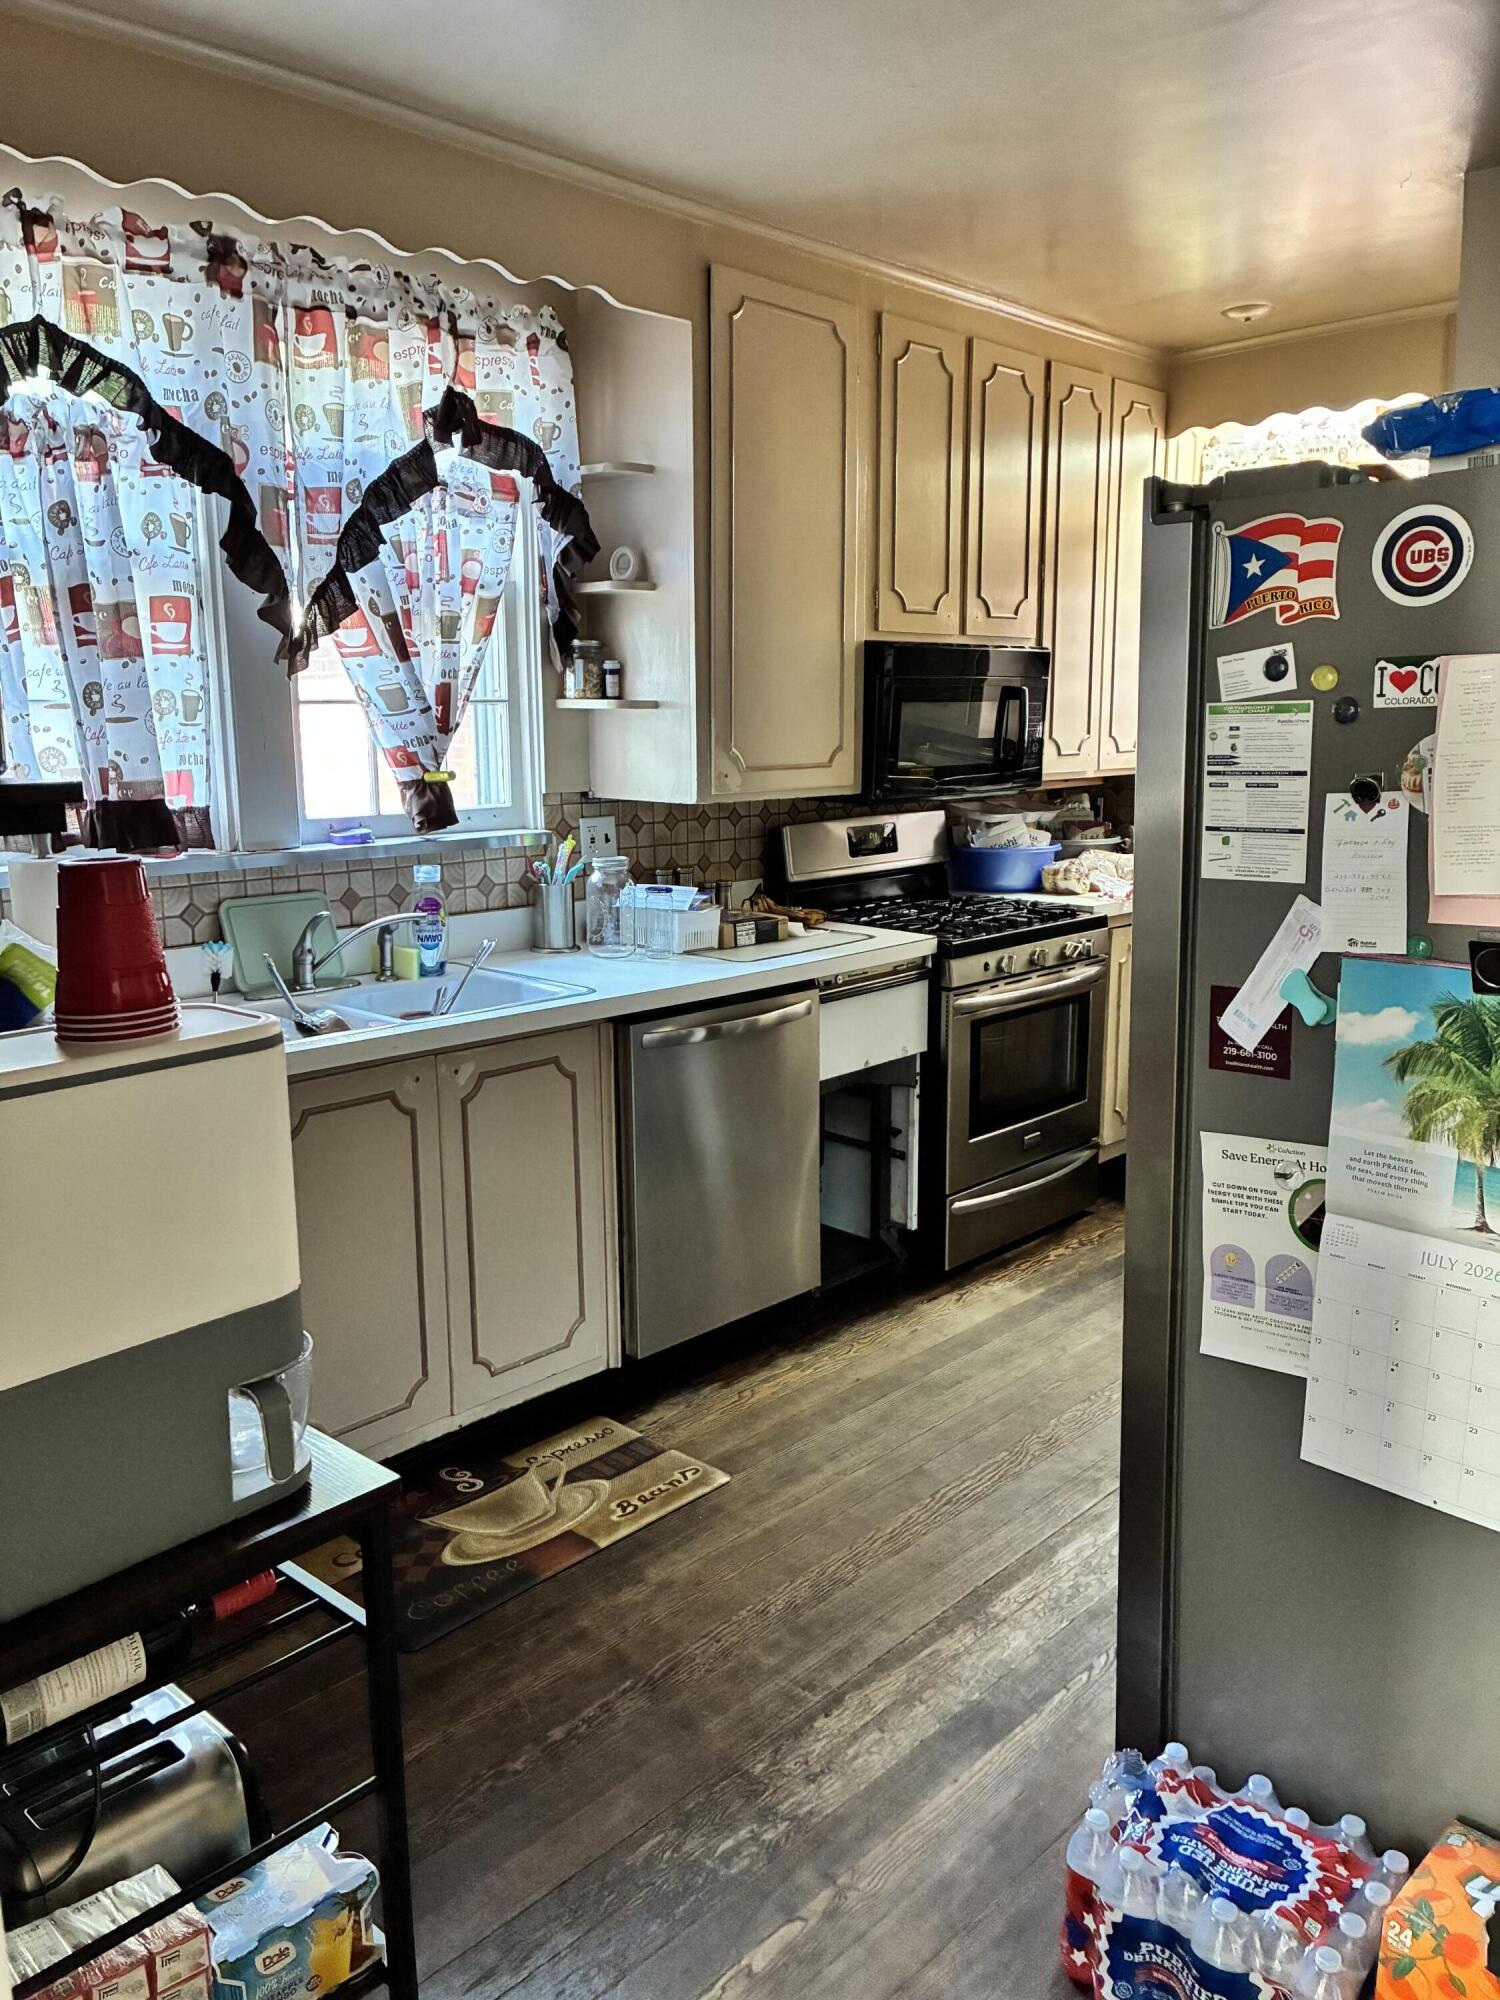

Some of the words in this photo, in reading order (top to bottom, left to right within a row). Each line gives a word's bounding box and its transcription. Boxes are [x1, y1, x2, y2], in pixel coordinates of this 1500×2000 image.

[1245, 589, 1297, 611] PUERTO
[1299, 598, 1333, 614] RICO
[1384, 696, 1436, 706] COLORADO
[417, 933, 443, 943] DAWN
[1223, 1046, 1278, 1061] 219-661-3100
[1221, 1149, 1248, 1162] Save
[1349, 1156, 1362, 1164] and
[1362, 1158, 1381, 1168] earth
[1382, 1162, 1409, 1173] PRAISE
[1363, 1148, 1375, 1157] Let
[1376, 1151, 1387, 1160] the
[1388, 1154, 1414, 1165] heaven
[1345, 1163, 1357, 1172] the
[1357, 1167, 1375, 1177] seas,
[1375, 1170, 1388, 1179] and
[1389, 1174, 1409, 1184] every
[1351, 1174, 1366, 1184] that
[1366, 1178, 1392, 1189] moveth
[1208, 1188, 1231, 1198] ENERGY
[1232, 1191, 1246, 1199] USE
[1246, 1194, 1263, 1202] WITH
[1264, 1197, 1284, 1206] THESE
[1212, 1181, 1225, 1189] CUT
[1226, 1183, 1248, 1192] DOWN
[1248, 1186, 1259, 1194] ON
[1260, 1188, 1278, 1197] YOUR
[1211, 1197, 1234, 1206] SIMPLE
[1235, 1200, 1249, 1208] TIPS
[1249, 1203, 1264, 1211] YOU
[1264, 1205, 1279, 1213] CAN
[1222, 1207, 1242, 1216] START
[1419, 1250, 1459, 1272] JULY
[1314, 1337, 1322, 1345] 12
[1391, 1360, 1400, 1369] 14
[1431, 1372, 1441, 1381] 15
[1474, 1385, 1483, 1394] 16
[1348, 1388, 1358, 1397] 20
[1387, 1400, 1395, 1409] 21
[1427, 1413, 1437, 1422] 22
[1468, 1426, 1479, 1436] 23
[1345, 1427, 1354, 1436] 27
[1383, 1441, 1392, 1449] 28
[1423, 1454, 1433, 1463] 29
[1464, 1467, 1475, 1478] 30
[1177, 1844, 1271, 1899] PURIFIED
[1218, 1859, 1291, 1893] DRINKING
[214, 1880, 244, 1900] Dole
[1387, 1920, 1413, 1948] 24
[262, 1945, 291, 1970] Dole
